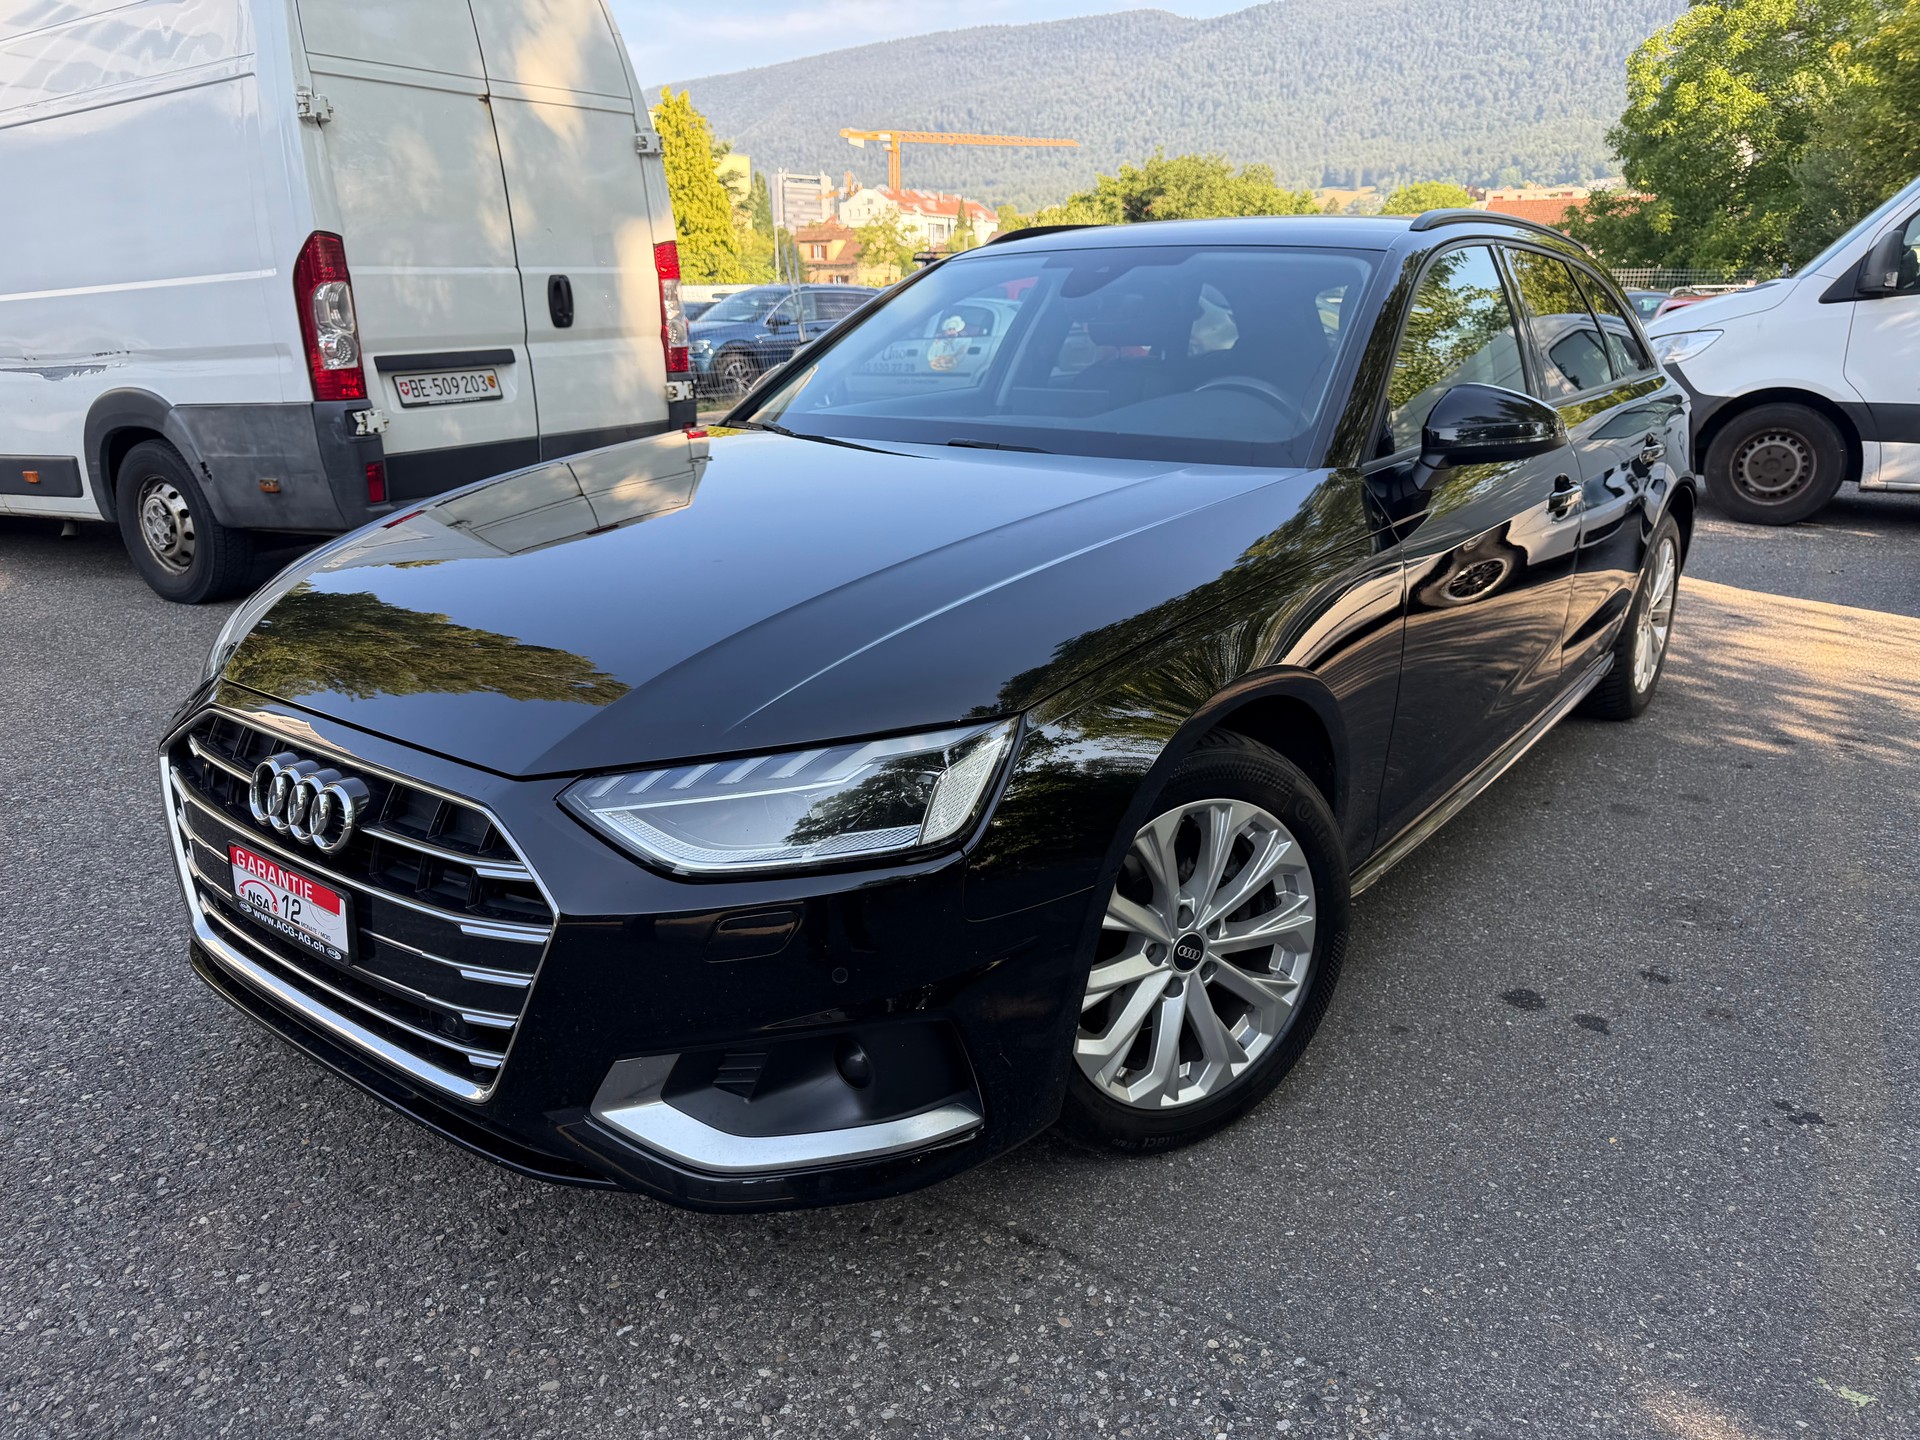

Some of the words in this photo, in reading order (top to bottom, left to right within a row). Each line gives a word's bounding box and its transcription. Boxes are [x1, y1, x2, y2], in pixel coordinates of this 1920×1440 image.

[236, 850, 313, 902] GARANTIE
[248, 890, 270, 912] NSA
[281, 894, 301, 925] 12
[252, 908, 325, 954] www.ACG-AG.ch
